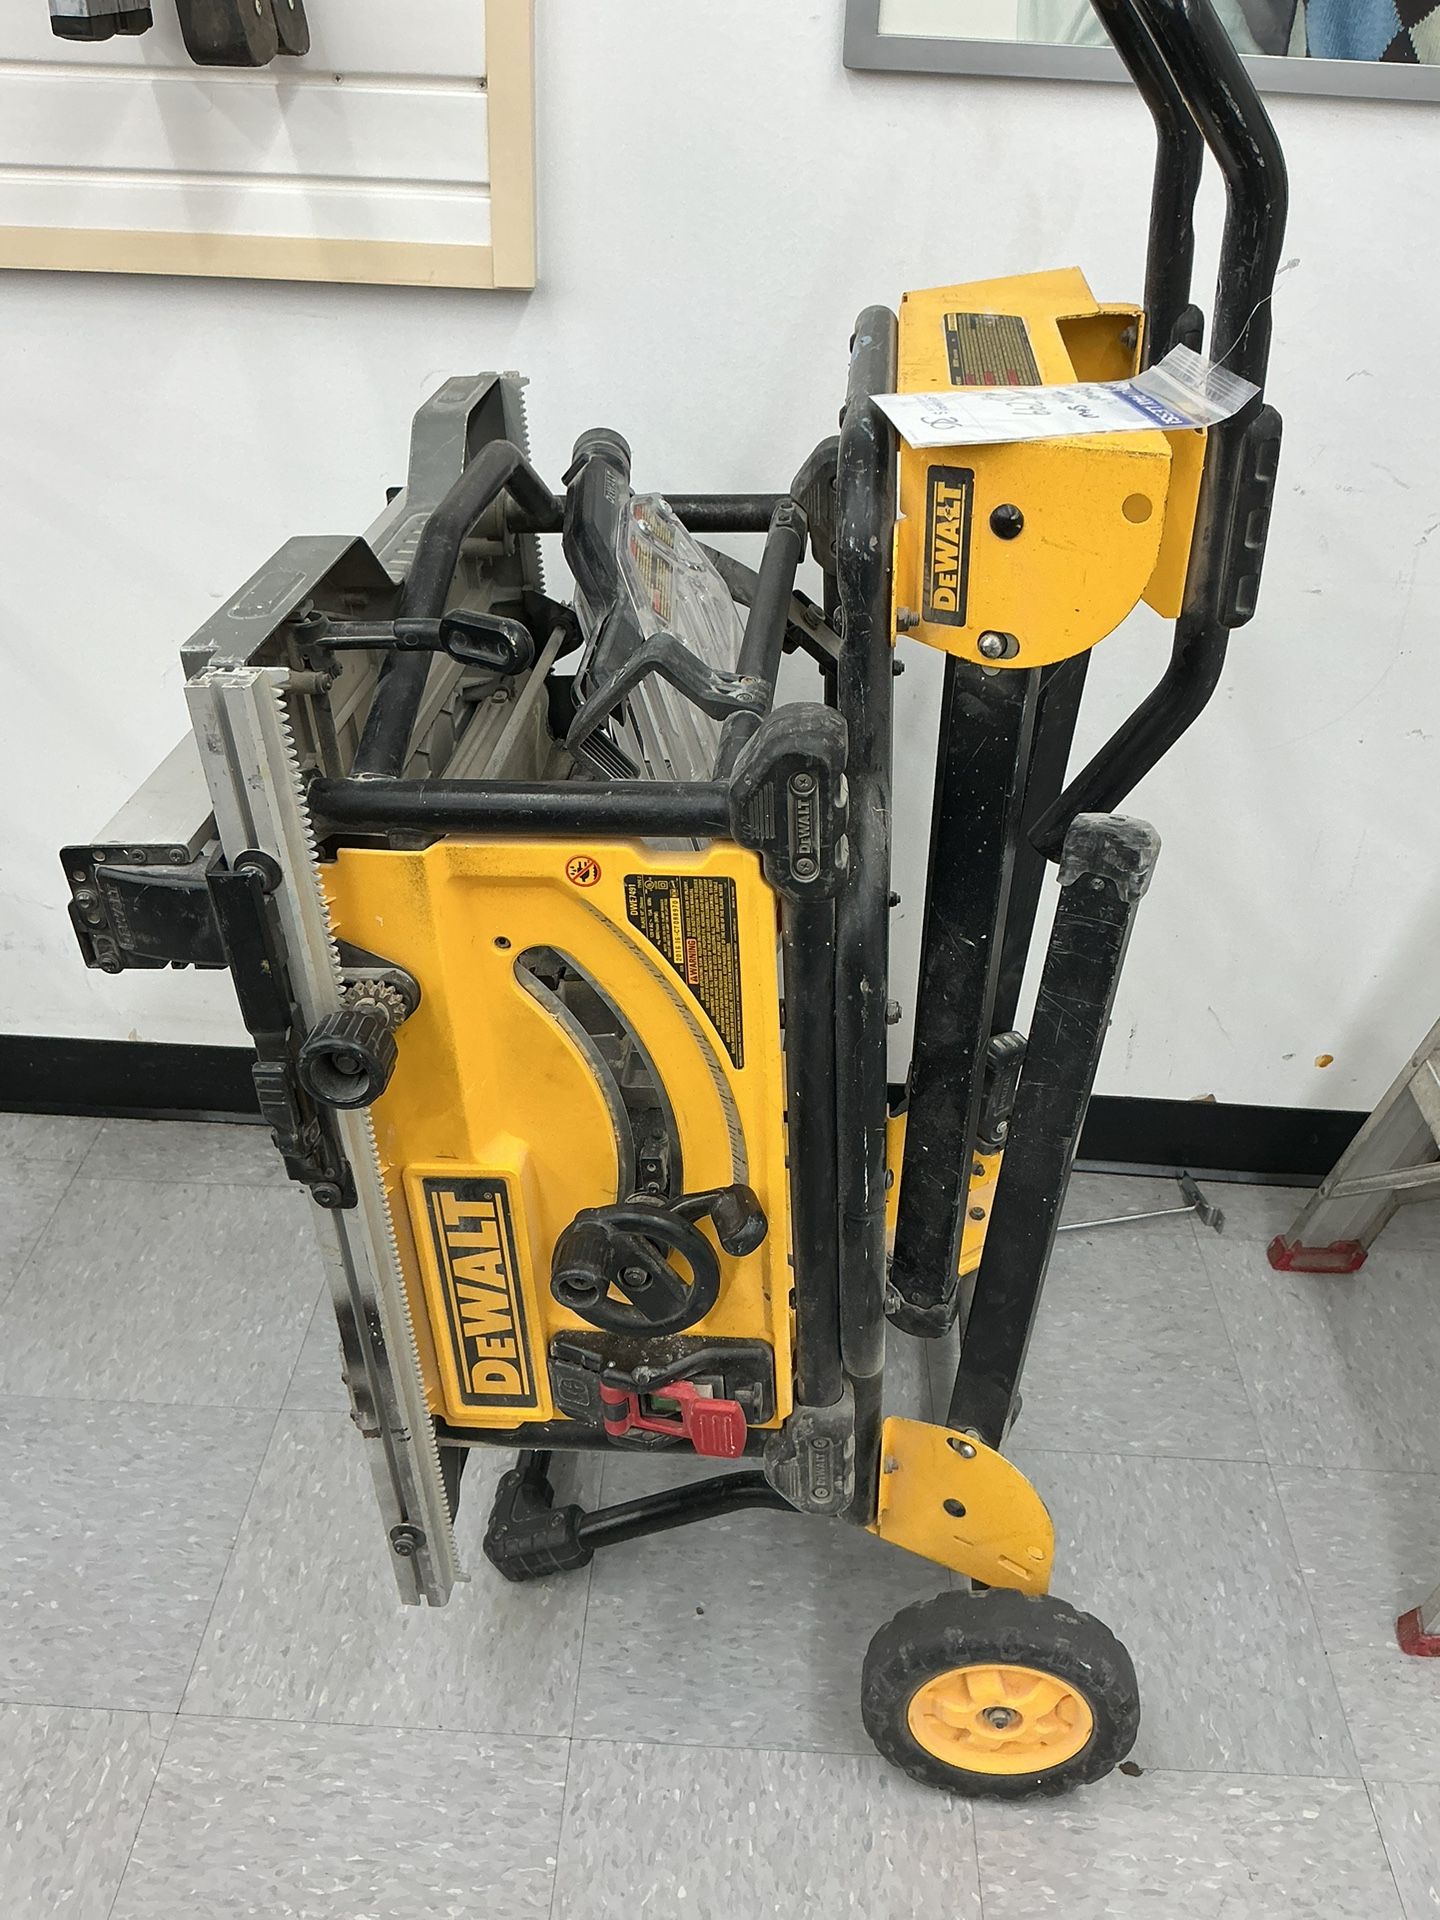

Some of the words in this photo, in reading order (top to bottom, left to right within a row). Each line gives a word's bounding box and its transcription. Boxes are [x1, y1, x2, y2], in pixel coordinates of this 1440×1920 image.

[932, 481, 963, 611] DEWALT
[798, 799, 811, 853] DEWALT
[629, 883, 638, 915] DWE7491
[688, 939, 697, 975] WARNING
[439, 1190, 523, 1396] DEWALT
